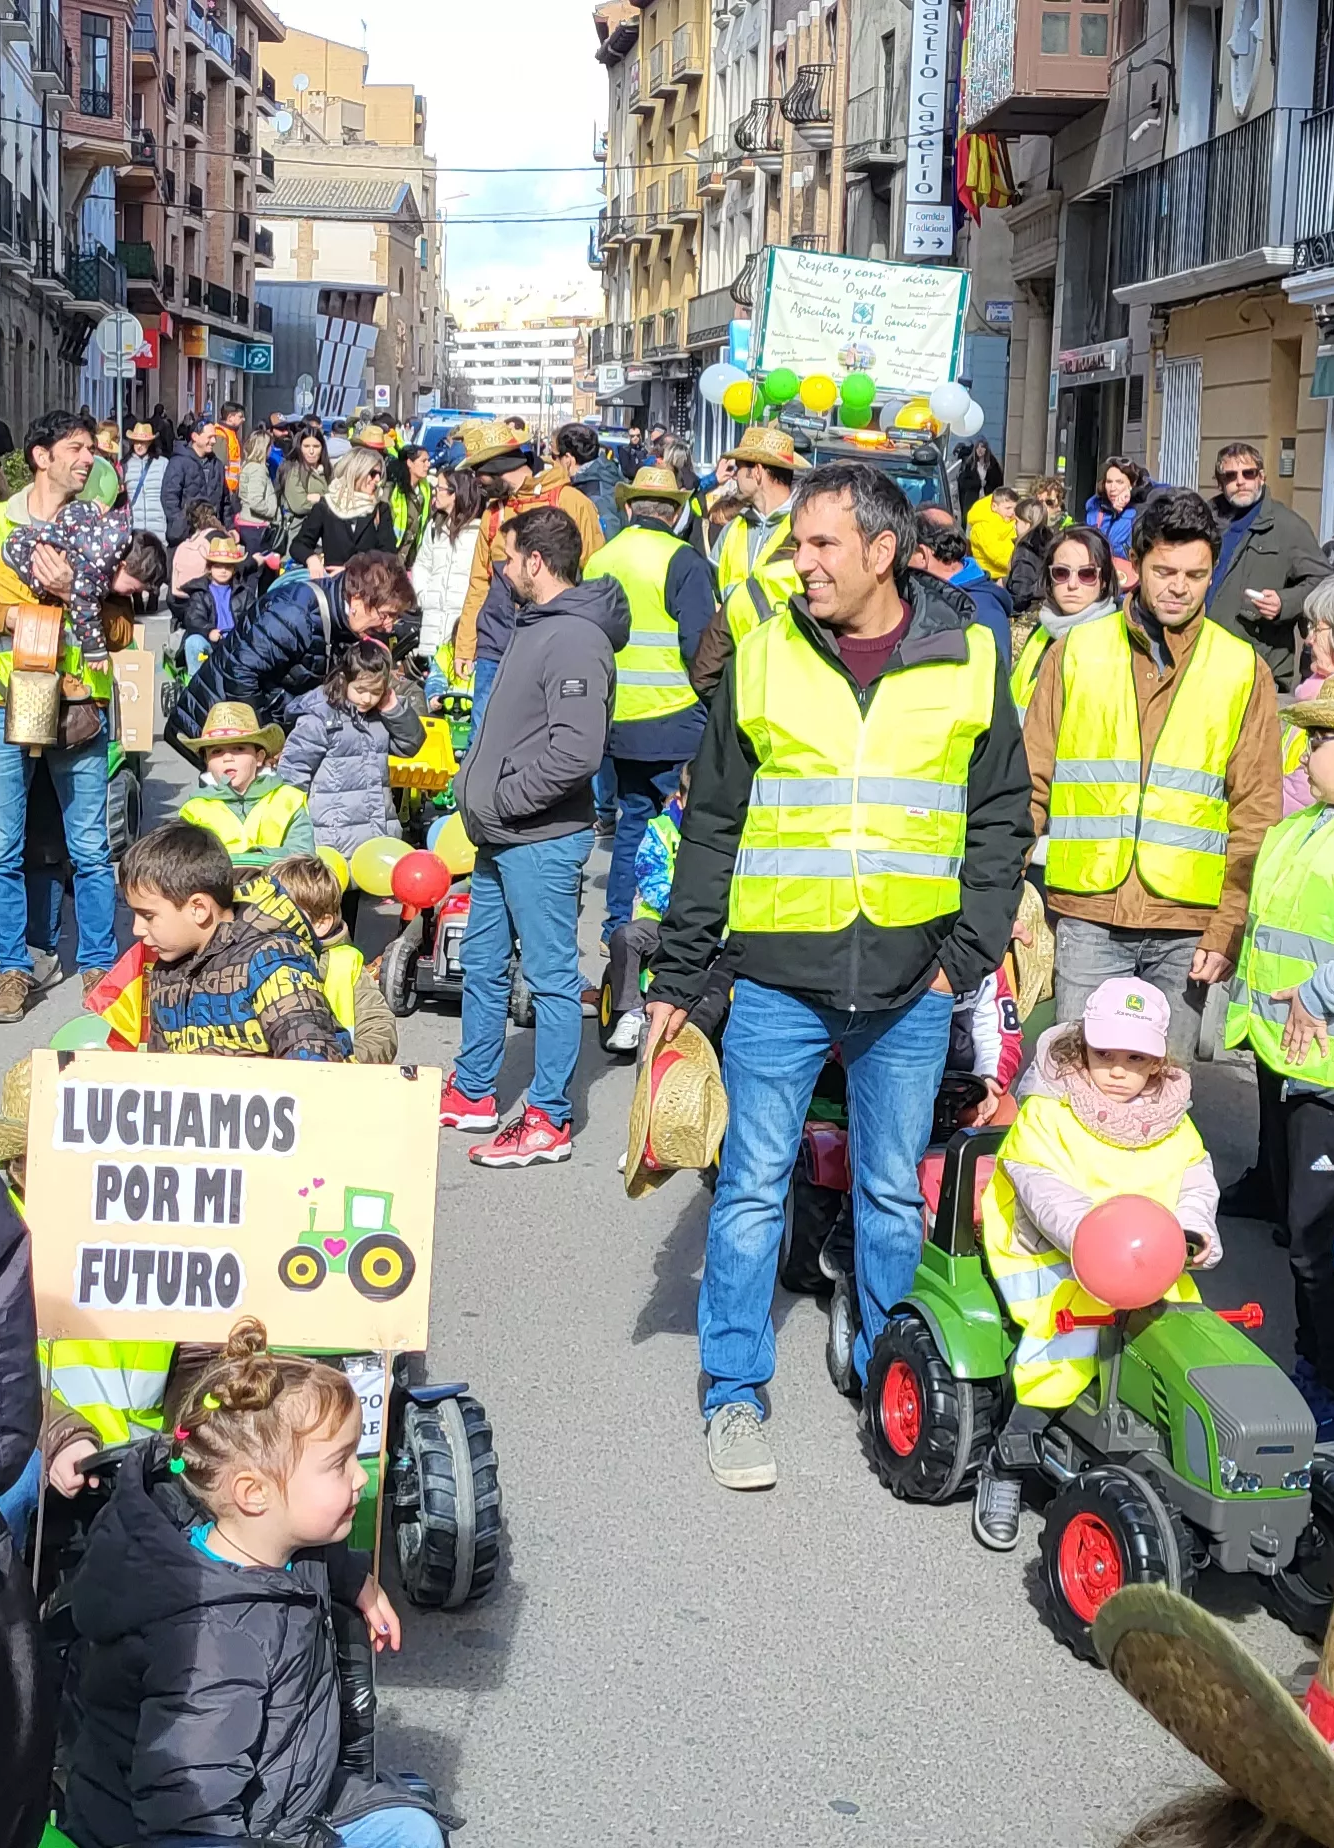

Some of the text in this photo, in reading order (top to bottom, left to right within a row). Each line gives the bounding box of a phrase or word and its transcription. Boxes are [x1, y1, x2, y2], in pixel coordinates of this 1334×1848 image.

[909, 223, 951, 233] Tradicional
[797, 254, 839, 275] Respeto
[845, 282, 887, 300] Orgullo
[820, 319, 845, 335] Vida
[859, 326, 896, 342] Futuro
[1001, 999, 1020, 1031] 8
[62, 1087, 296, 1153] LUCHAMOS
[95, 1164, 243, 1224] POR MI
[78, 1247, 241, 1309] FUTURO
